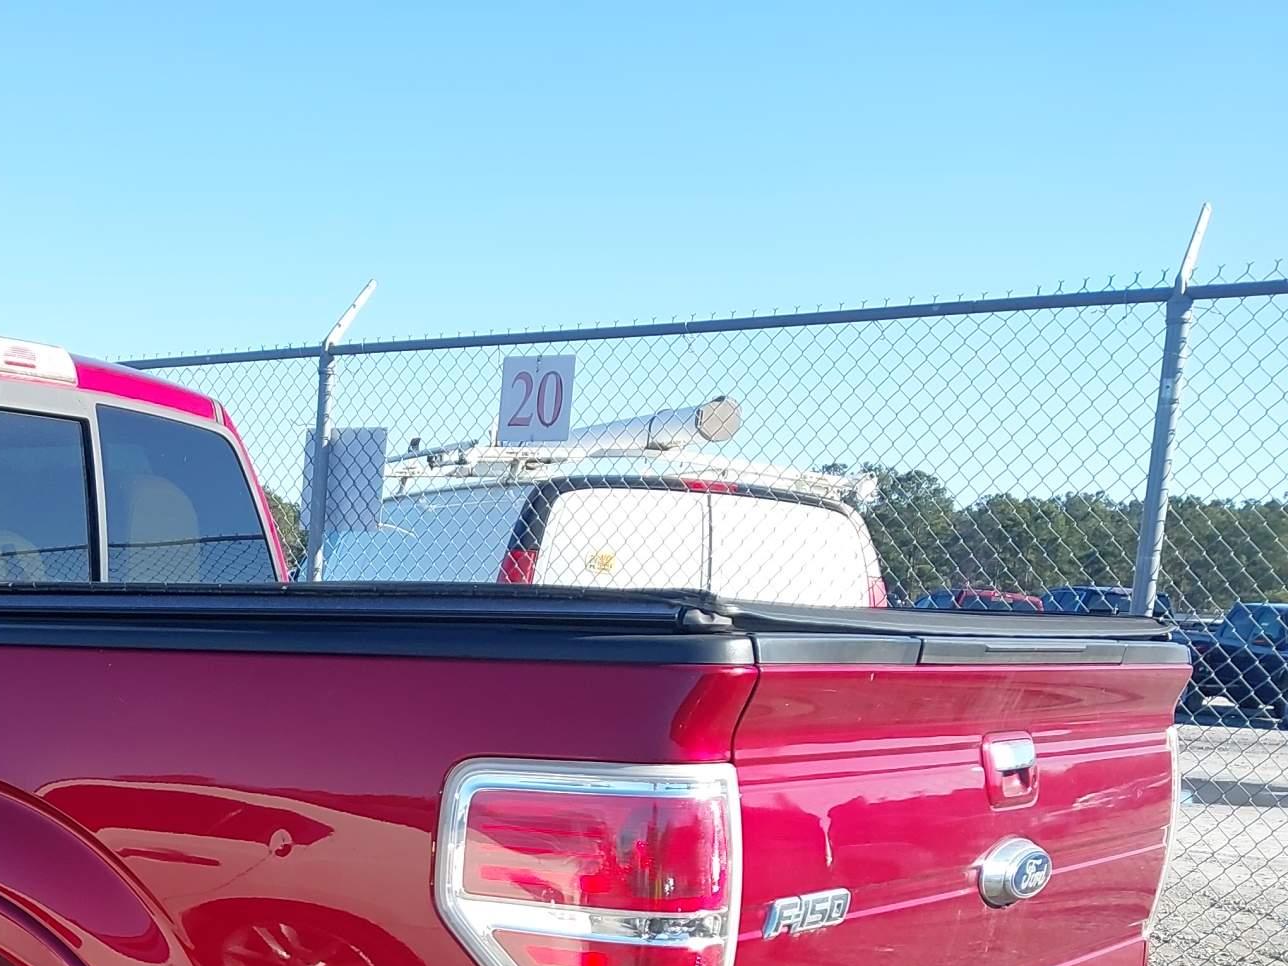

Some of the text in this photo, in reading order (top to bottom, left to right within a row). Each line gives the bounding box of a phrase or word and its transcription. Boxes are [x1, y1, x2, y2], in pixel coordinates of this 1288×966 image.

[507, 370, 564, 428] 20
[1021, 859, 1048, 889] Ford
[767, 889, 851, 936] F-150
